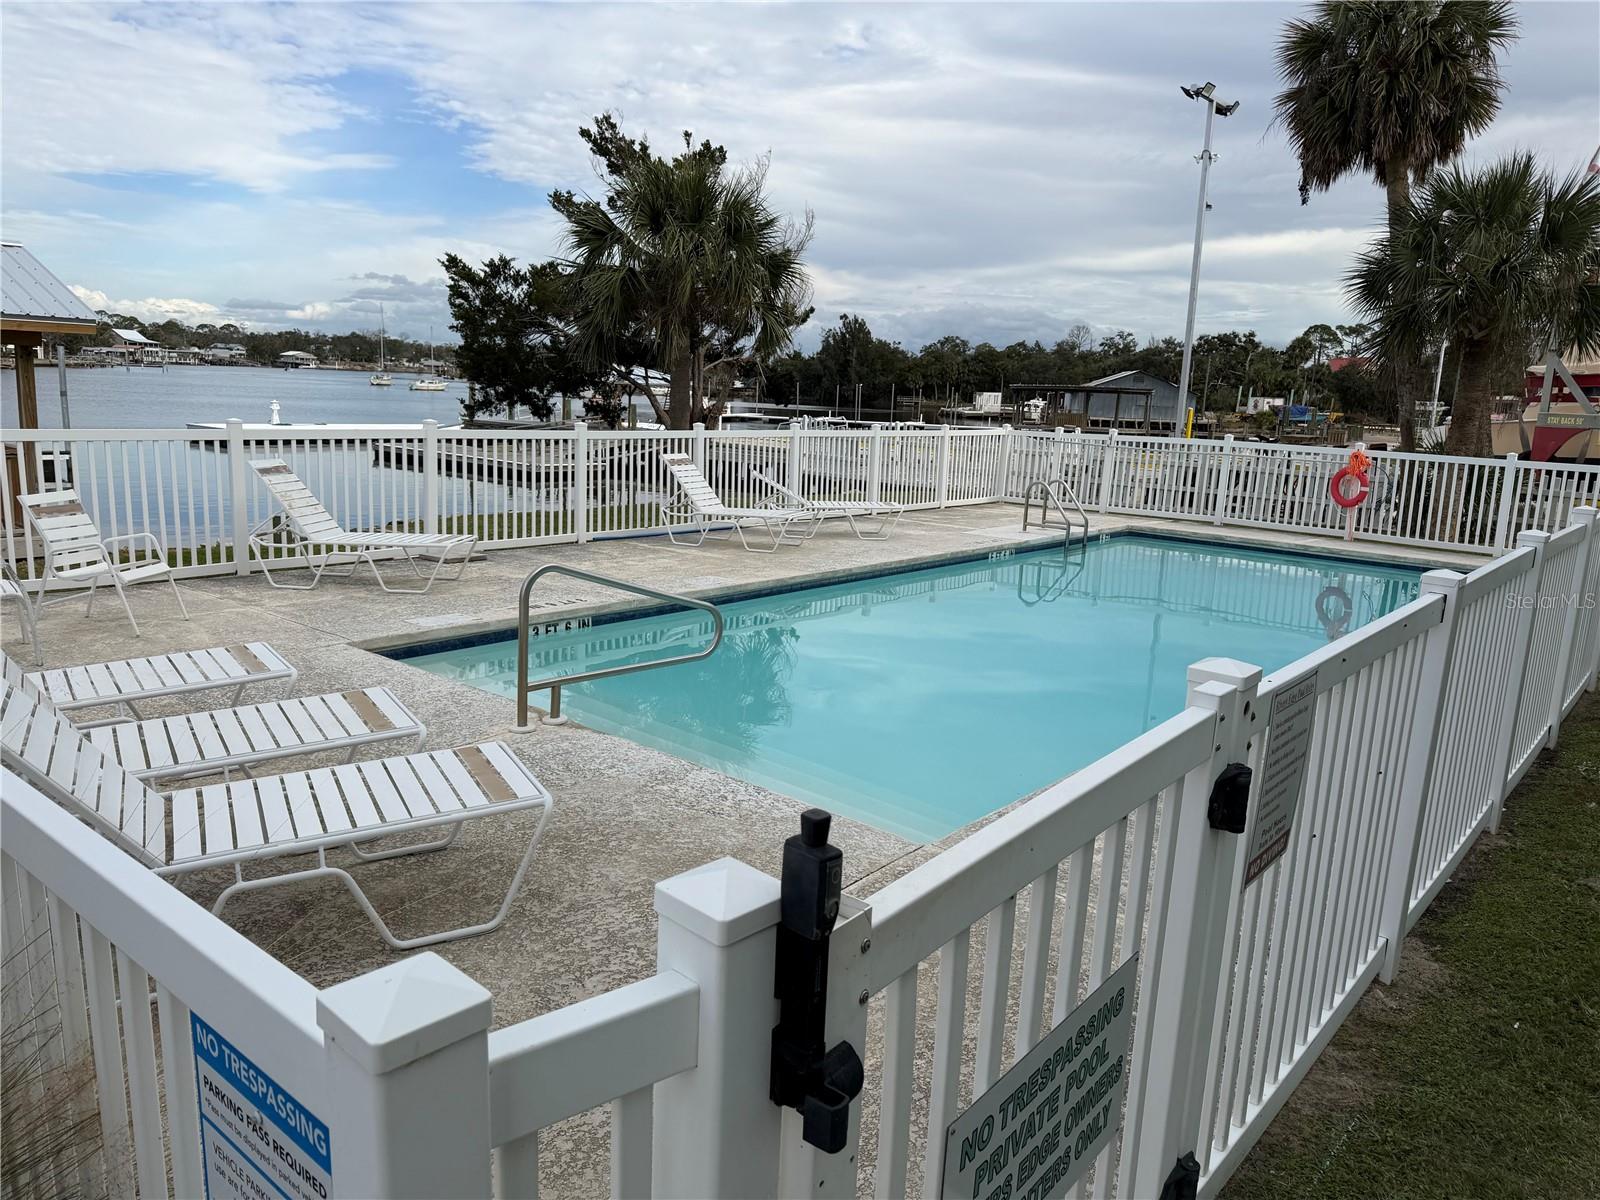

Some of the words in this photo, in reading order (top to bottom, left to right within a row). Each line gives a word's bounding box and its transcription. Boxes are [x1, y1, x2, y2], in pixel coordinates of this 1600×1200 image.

[1547, 416, 1560, 425] STAY
[1560, 416, 1576, 425] BACK
[545, 622, 559, 634] FT
[578, 618, 590, 629] IN
[1248, 858, 1261, 879] NO
[196, 1022, 219, 1059] NO
[221, 1044, 327, 1158] TRESPASSING
[959, 1114, 995, 1173] NO
[998, 986, 1125, 1132] TRESPASSING
[203, 1073, 245, 1123] PARKING
[246, 1112, 270, 1147] PASS
[272, 1138, 327, 1200] REQUIRED
[972, 1085, 1062, 1200] PRIVATE
[1064, 1038, 1110, 1104] POOL
[1015, 1118, 1063, 1193] EDGE
[1063, 1053, 1124, 1139] OWNERS
[1073, 1096, 1113, 1162] ONLY
[212, 1139, 245, 1183] VEHICLE
[214, 1161, 227, 1180] use
[227, 1175, 239, 1194] are
